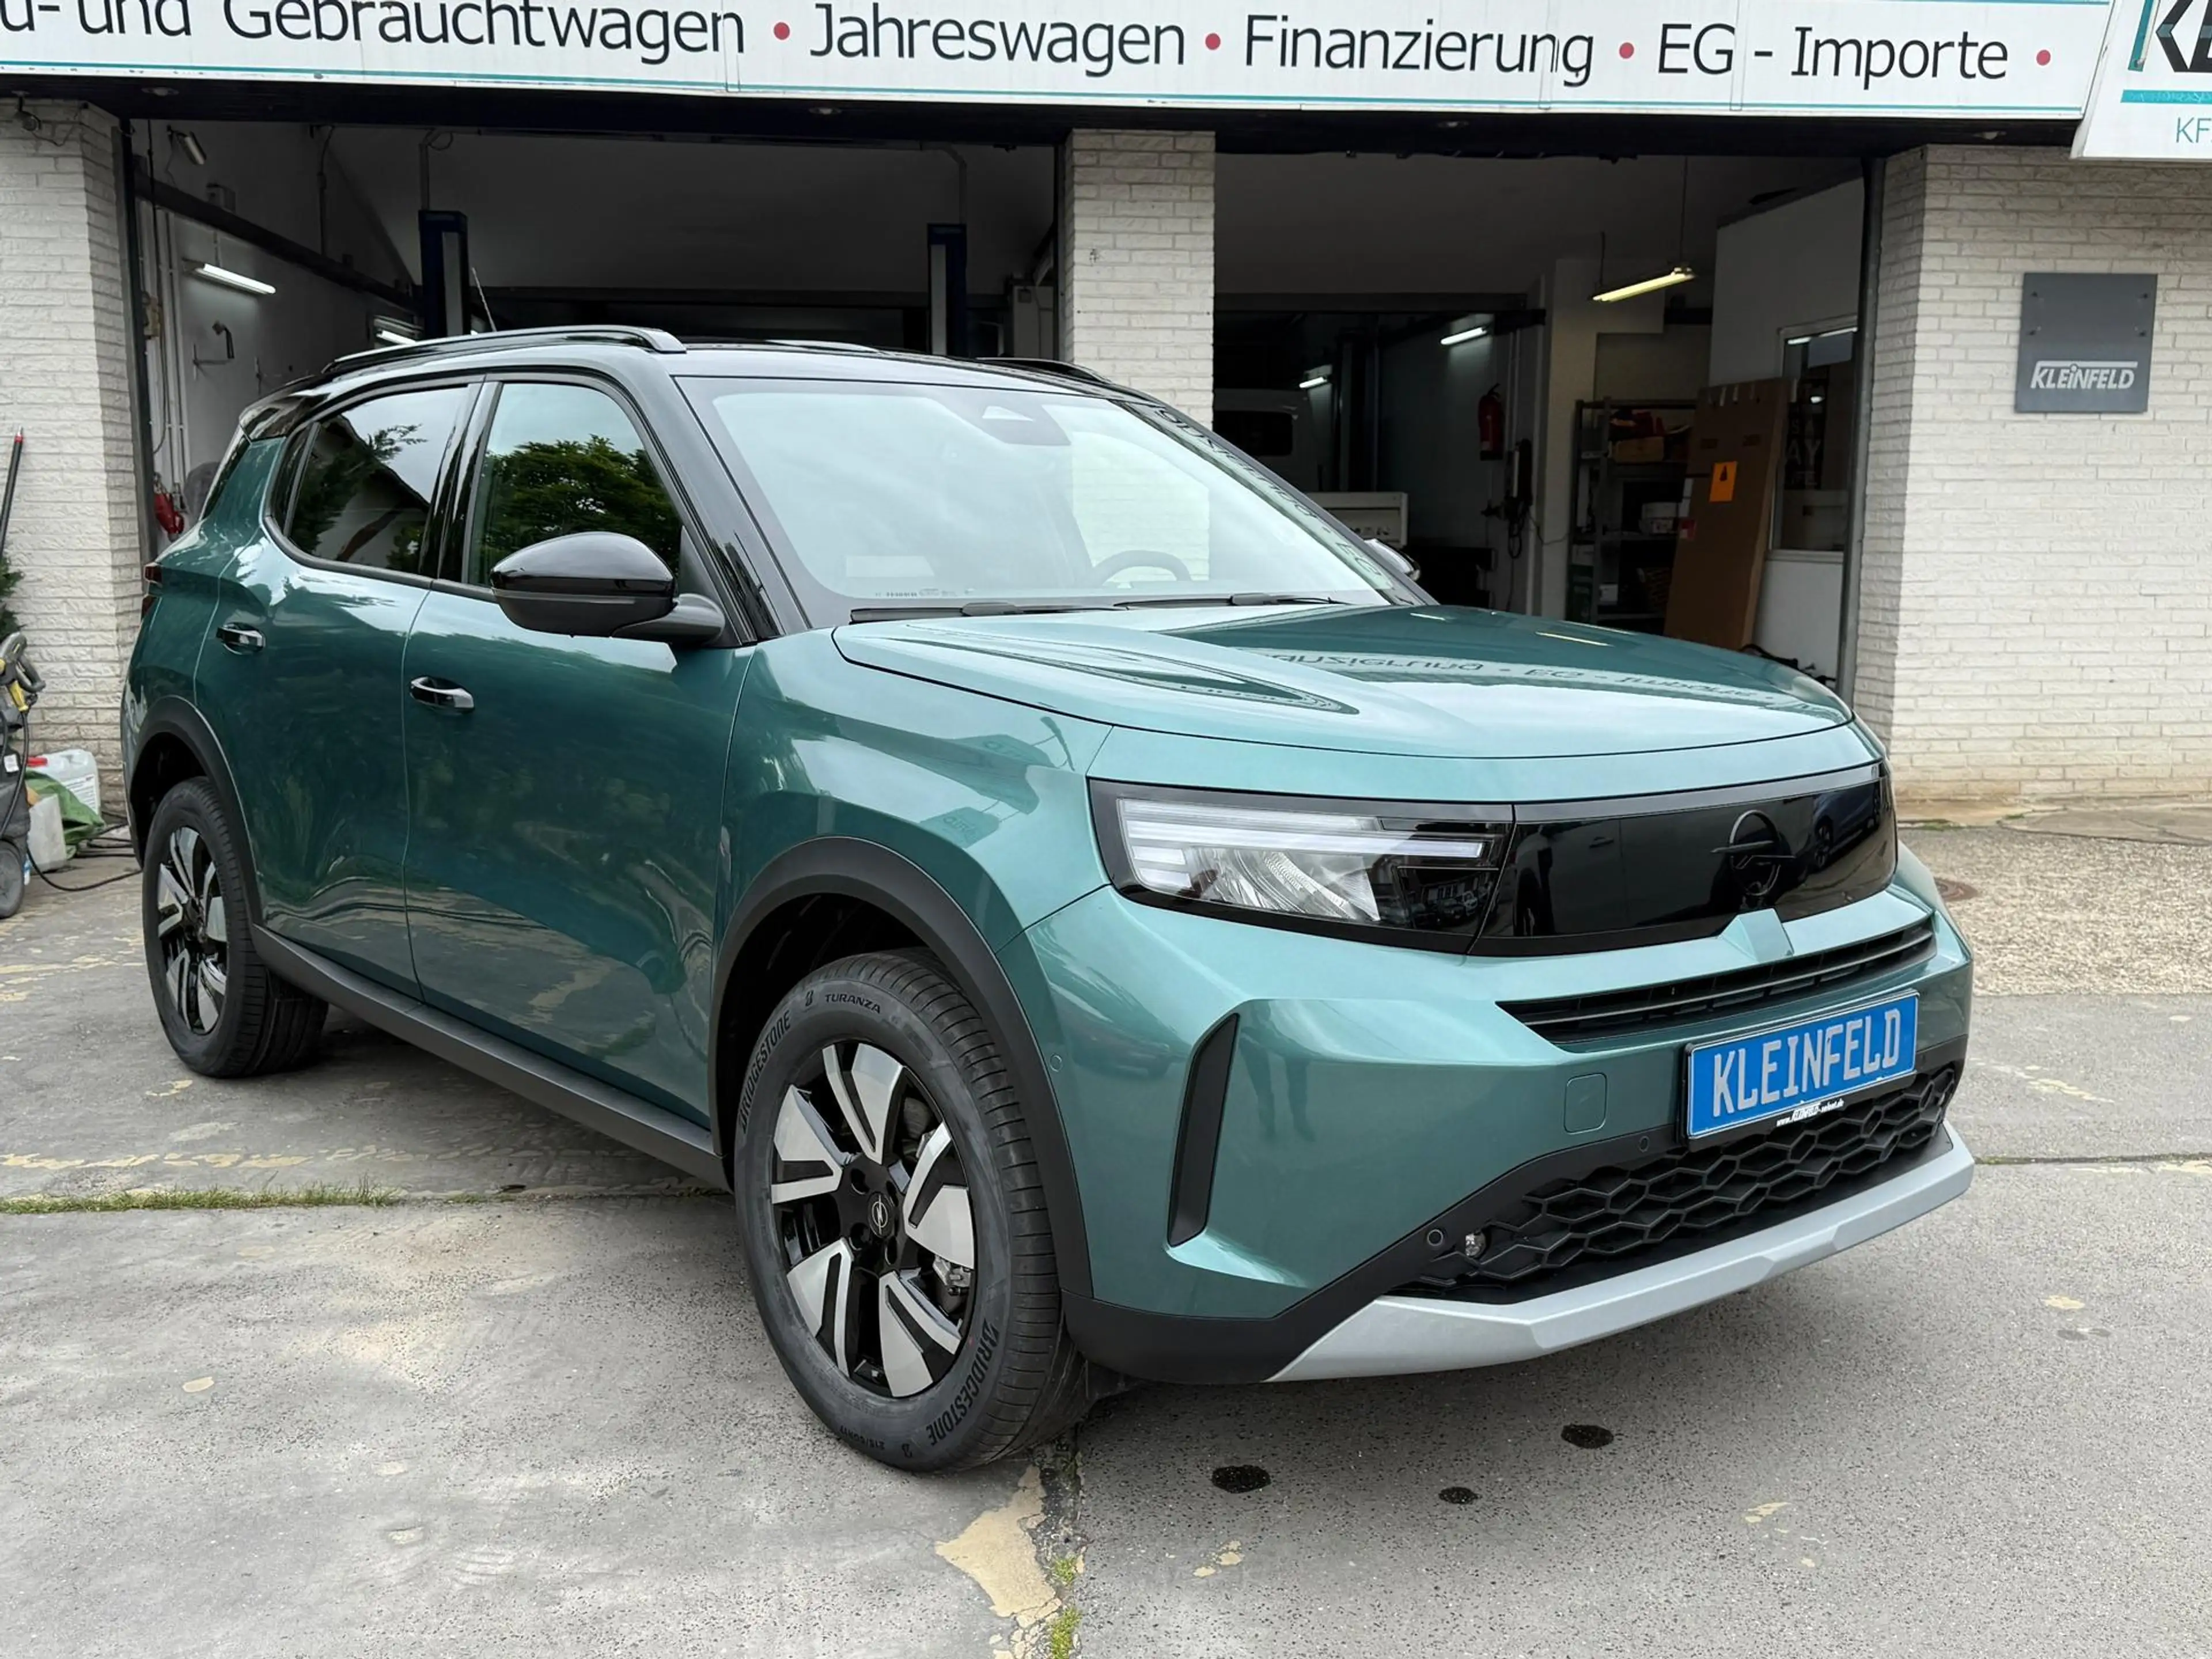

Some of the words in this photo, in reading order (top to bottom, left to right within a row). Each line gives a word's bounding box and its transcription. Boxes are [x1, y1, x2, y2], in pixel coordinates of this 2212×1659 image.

[78, 0, 192, 36] und
[224, 0, 744, 65] Gebrauchtwagen
[810, 2, 1184, 77] Jahreswagen
[1246, 14, 1593, 87] Finanzierung
[1658, 23, 1735, 75] EG
[1791, 26, 2008, 90] Importe
[2176, 117, 2212, 143] KF
[824, 994, 881, 1014] TURANZA
[738, 1009, 791, 1135] BRIDGESTONE
[1712, 1008, 1902, 1118] KLEINFELD
[925, 1317, 1000, 1447] BRIDGESTONE
